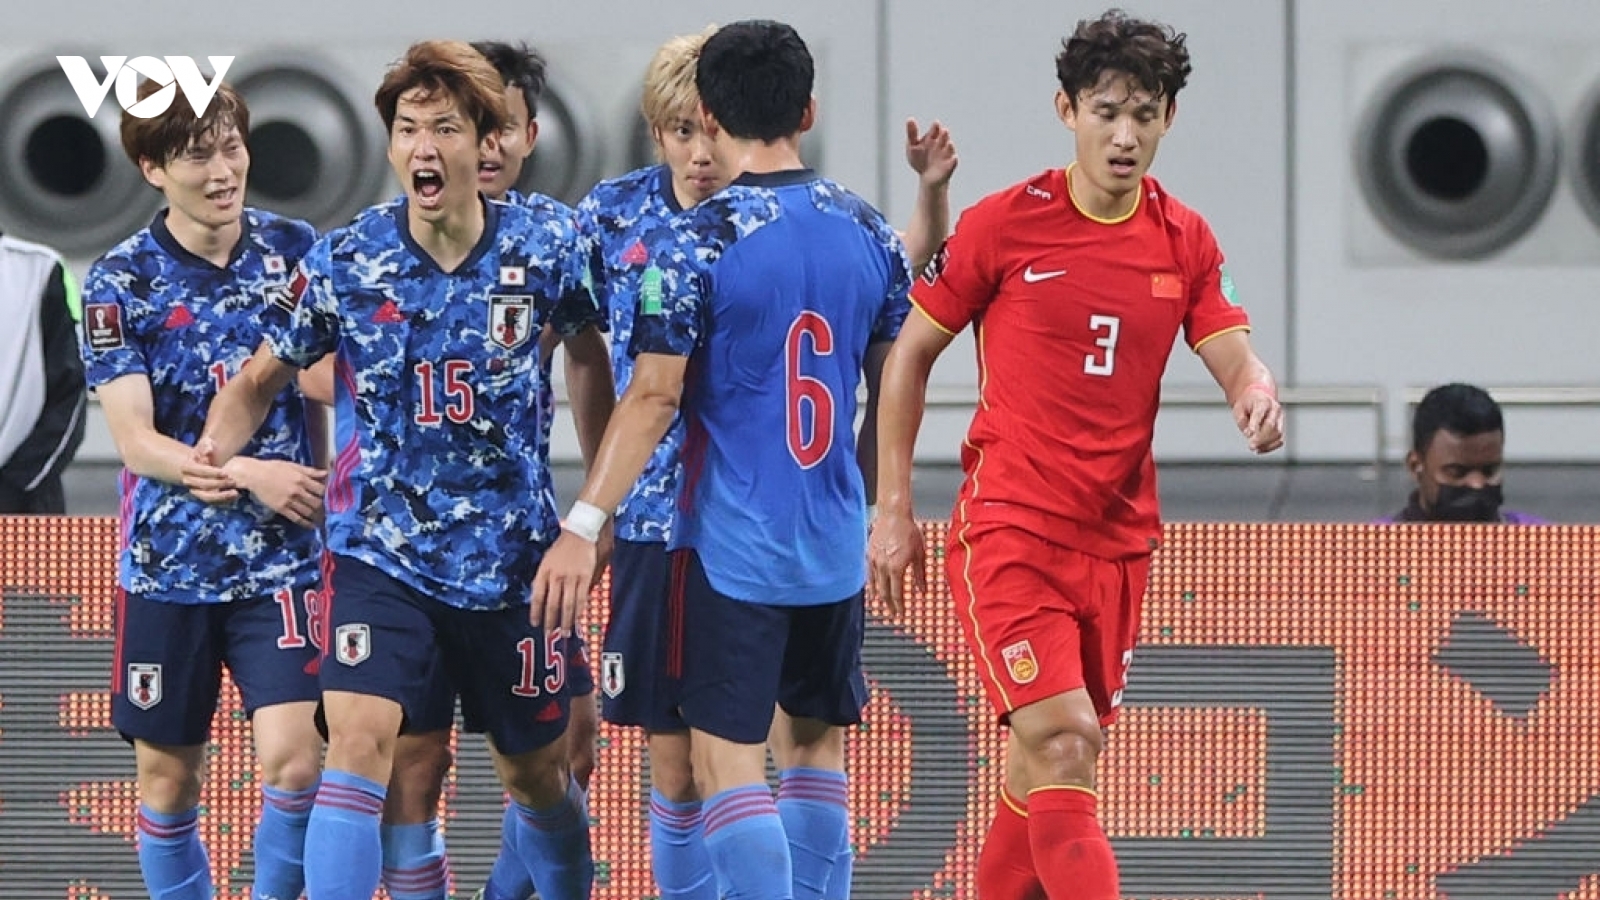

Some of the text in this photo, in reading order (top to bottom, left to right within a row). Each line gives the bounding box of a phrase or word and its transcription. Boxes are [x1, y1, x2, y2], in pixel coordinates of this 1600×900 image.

[208, 356, 253, 393] 1
[1084, 315, 1119, 376] 3
[414, 359, 475, 425] 15
[785, 311, 835, 470] 6
[511, 627, 565, 698] 15
